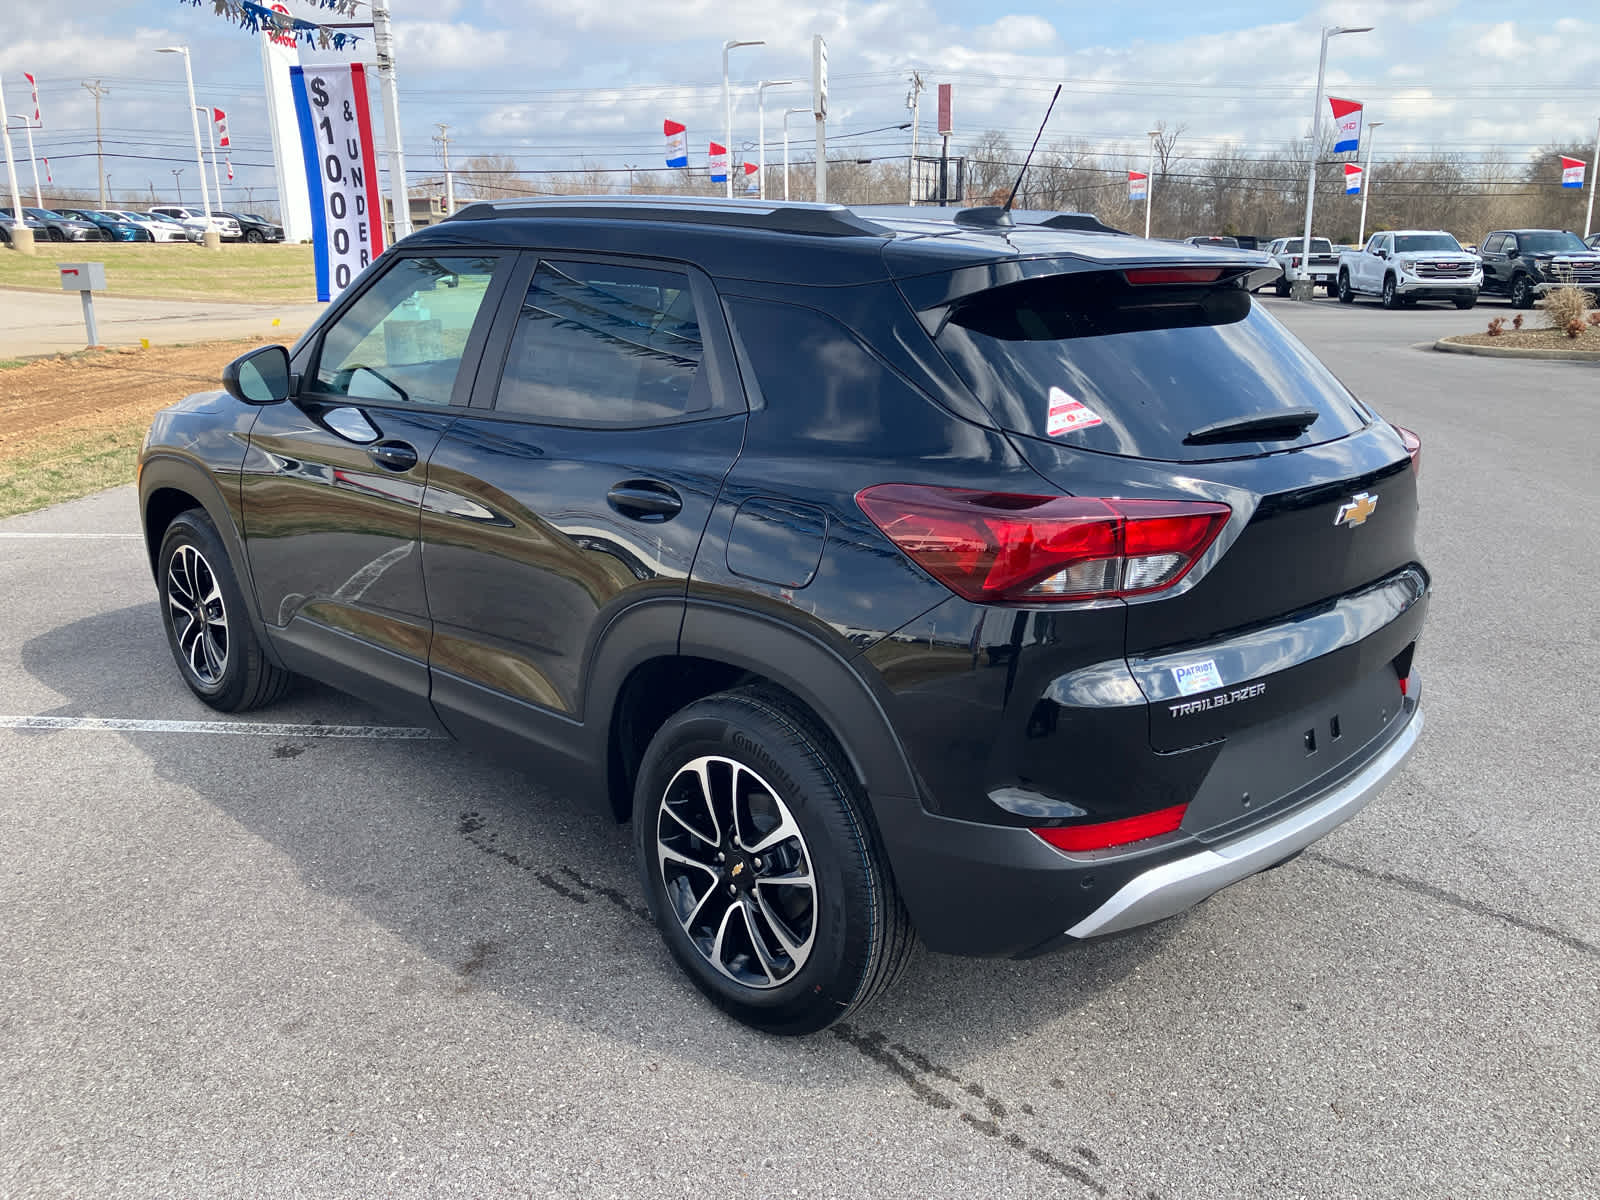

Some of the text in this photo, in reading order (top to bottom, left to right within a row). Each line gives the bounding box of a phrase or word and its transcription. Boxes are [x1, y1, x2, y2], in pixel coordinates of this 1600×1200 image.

[267, 30, 298, 49] TOYOTA
[310, 76, 350, 289] $10,000
[343, 100, 369, 269] & UNDER
[1175, 662, 1213, 683] PATRIOT
[1168, 683, 1266, 718] TRAILBLAZER
